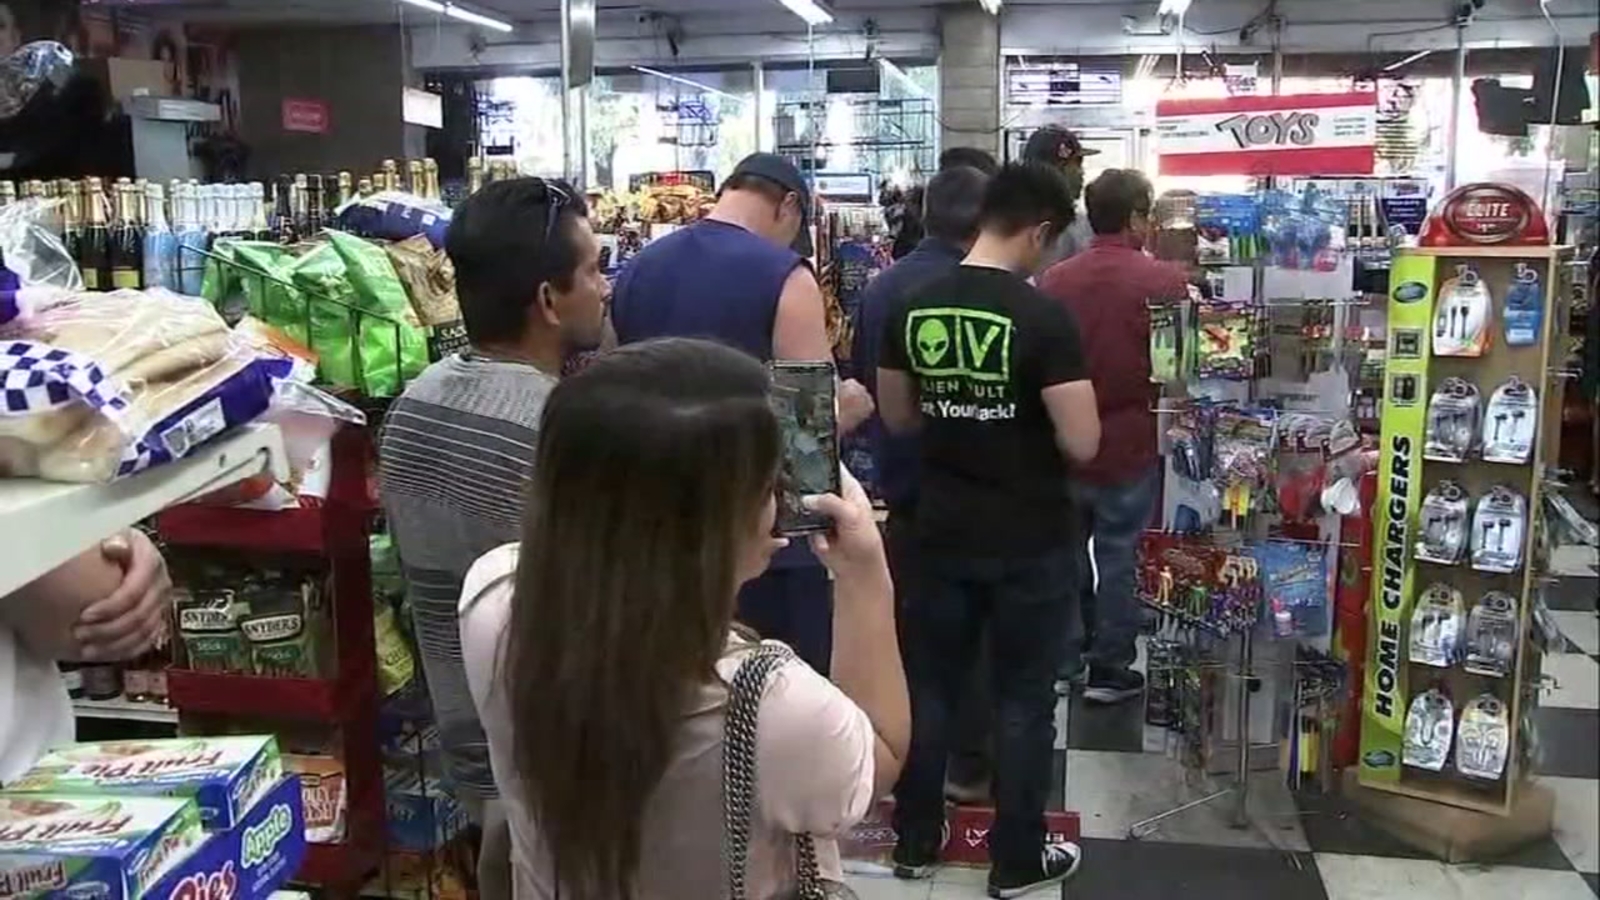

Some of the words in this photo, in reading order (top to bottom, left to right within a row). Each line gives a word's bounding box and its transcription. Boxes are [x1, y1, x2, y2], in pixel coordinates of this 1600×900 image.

[1215, 112, 1320, 149] TOYS
[1466, 202, 1511, 217] ELITE
[977, 403, 1016, 421] ack!
[1381, 434, 1412, 611] CHARGERS
[1374, 620, 1399, 718] HOME
[81, 759, 137, 778] Pie
[139, 750, 224, 775] Fruit
[40, 816, 133, 840] Fruit
[240, 804, 292, 869] Apple
[14, 860, 66, 890] Fruit
